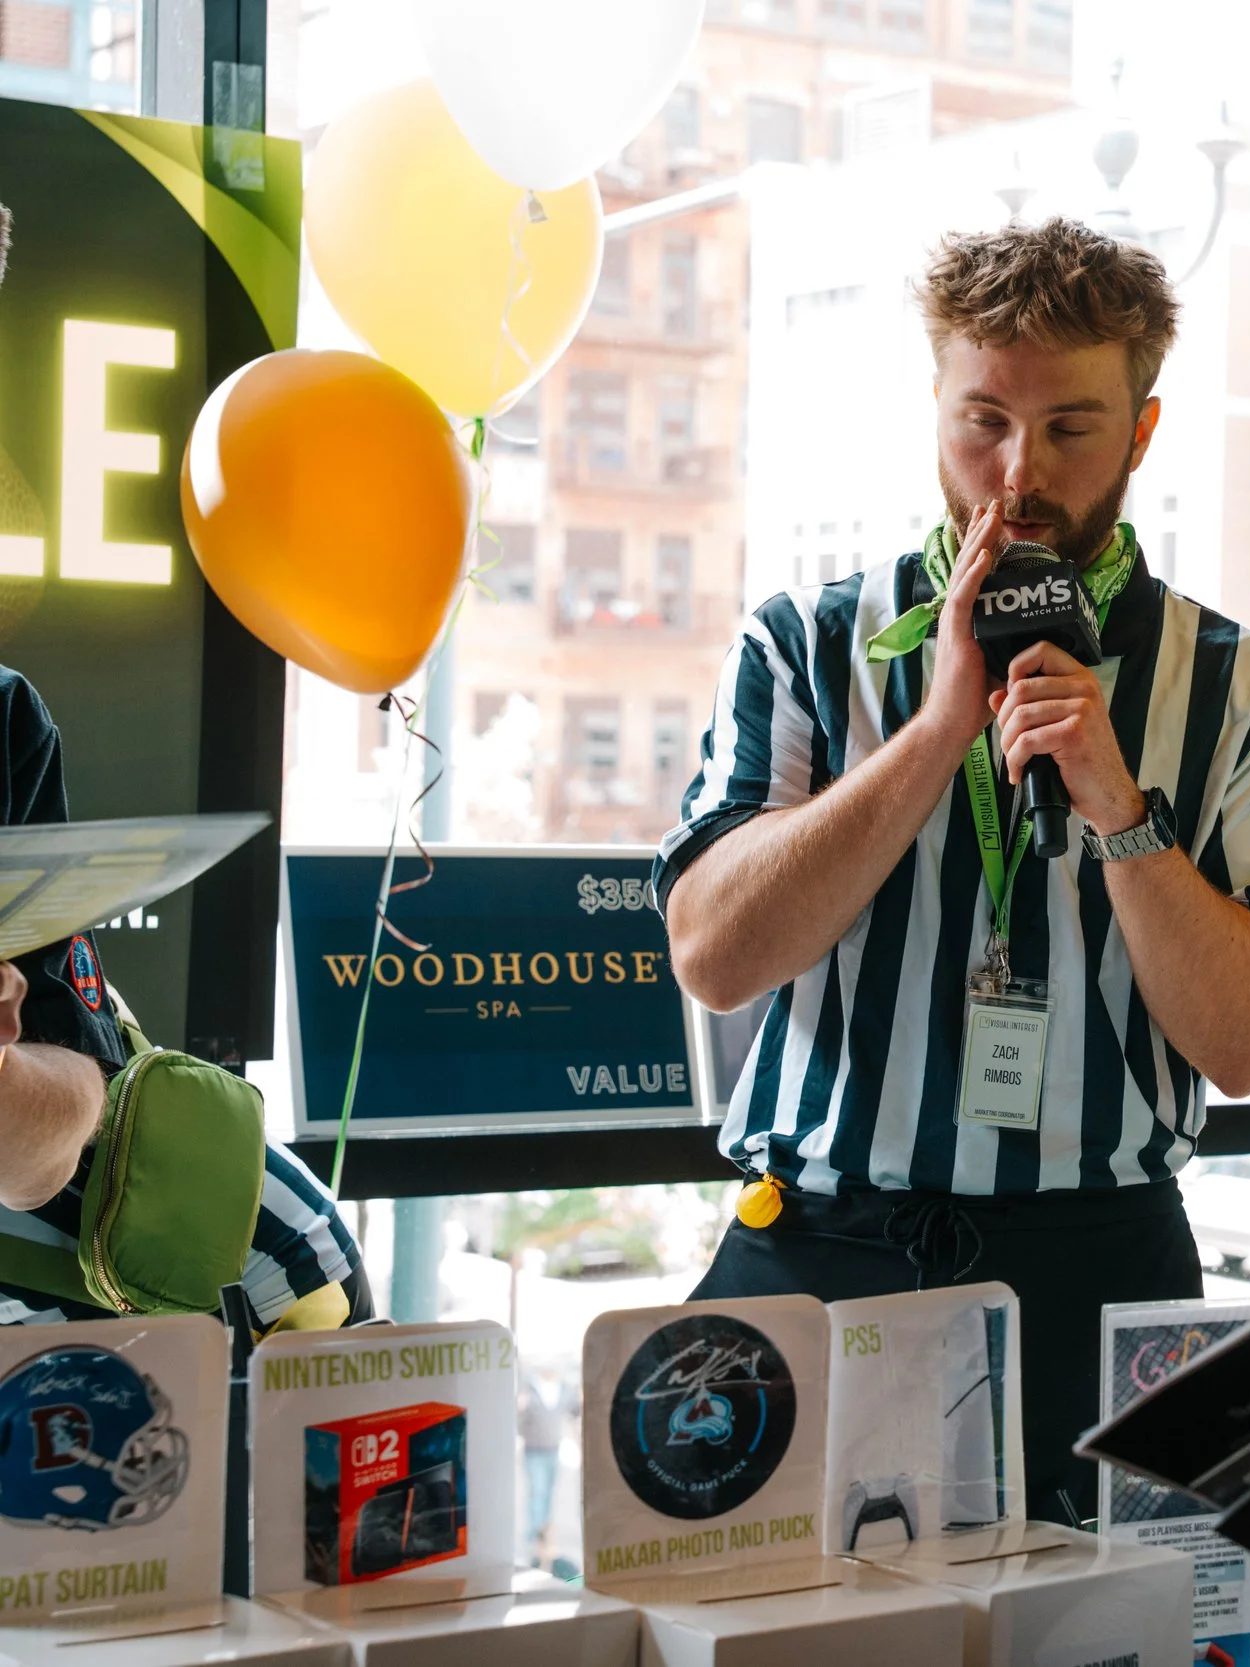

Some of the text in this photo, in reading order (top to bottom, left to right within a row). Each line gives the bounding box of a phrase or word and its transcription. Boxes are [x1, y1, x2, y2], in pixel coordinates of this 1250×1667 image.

[978, 575, 1072, 615] TOM'S
[1021, 604, 1073, 618] WATCH BAR
[476, 1001, 522, 1020] SPA
[992, 1044, 1020, 1061] ZACH
[566, 1063, 687, 1095] VALUE
[983, 1068, 1022, 1086] RIMBOS
[842, 1323, 883, 1358] PS5
[264, 1337, 512, 1392] NINTENDO SWITCH 2
[379, 1430, 399, 1461] 2
[647, 1458, 749, 1492] OFFICIAL GAME PUCK
[597, 1513, 816, 1575] MAKAR PHOTO AND PUCK
[1157, 1522, 1192, 1536] PLAYHOUSE
[0, 1558, 168, 1609] PAT SURTAIN
